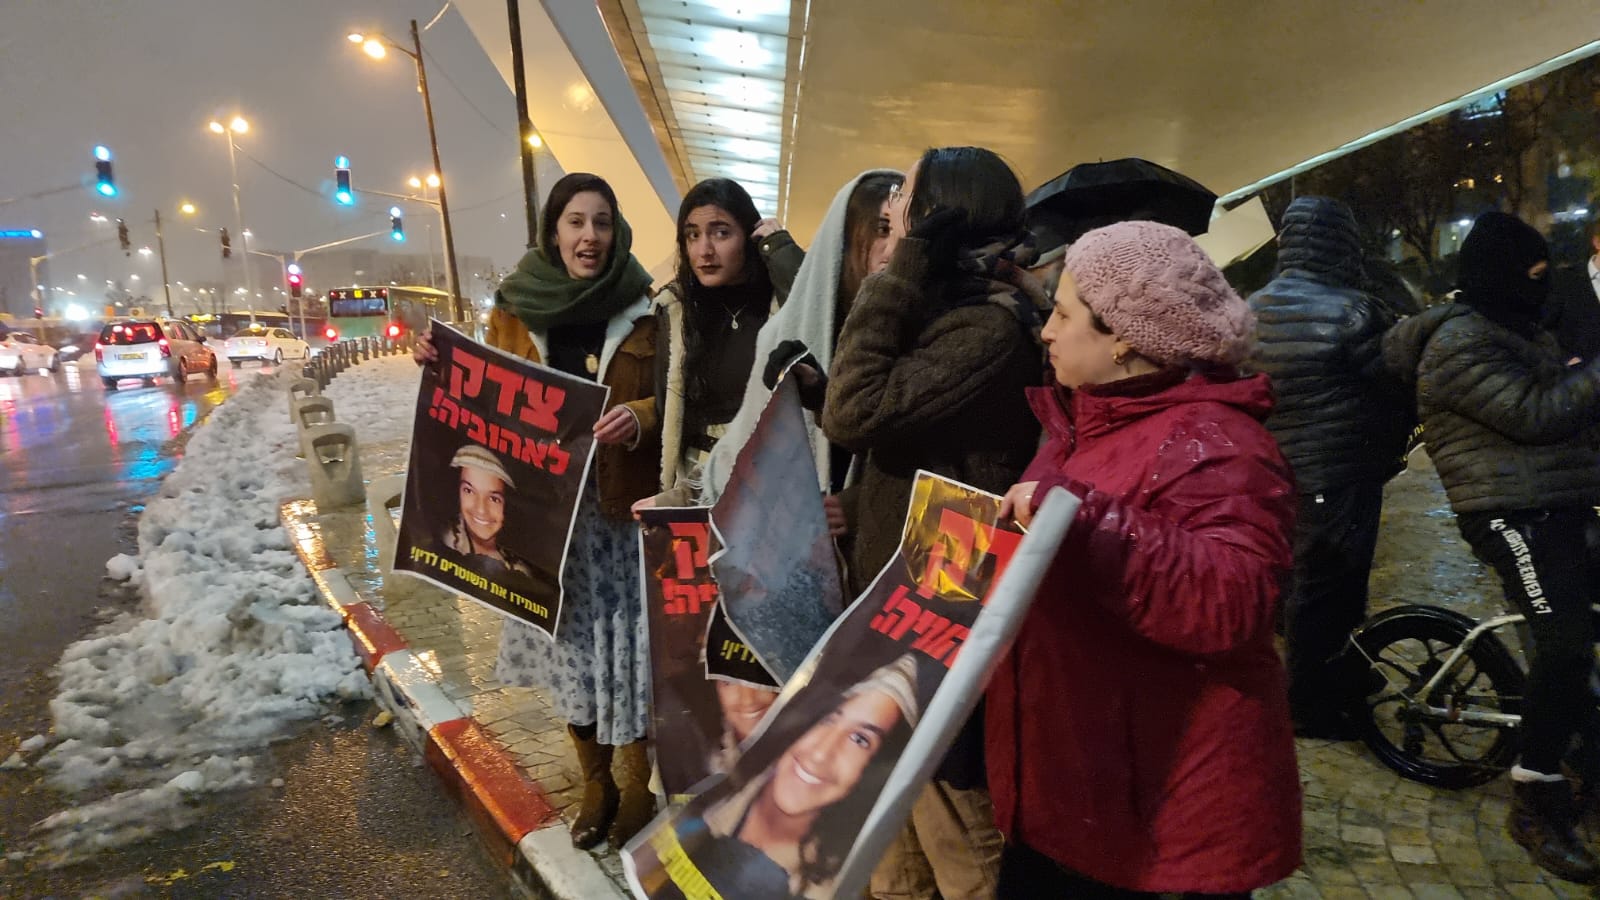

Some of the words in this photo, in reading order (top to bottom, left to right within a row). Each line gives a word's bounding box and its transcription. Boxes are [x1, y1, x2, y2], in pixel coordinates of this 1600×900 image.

[450, 347, 565, 431] צדק
[429, 388, 570, 475] לאהוביה!
[440, 558, 488, 590] השוטרים
[916, 508, 1024, 606] דק
[490, 582, 508, 599] את
[510, 591, 549, 619] העמידו
